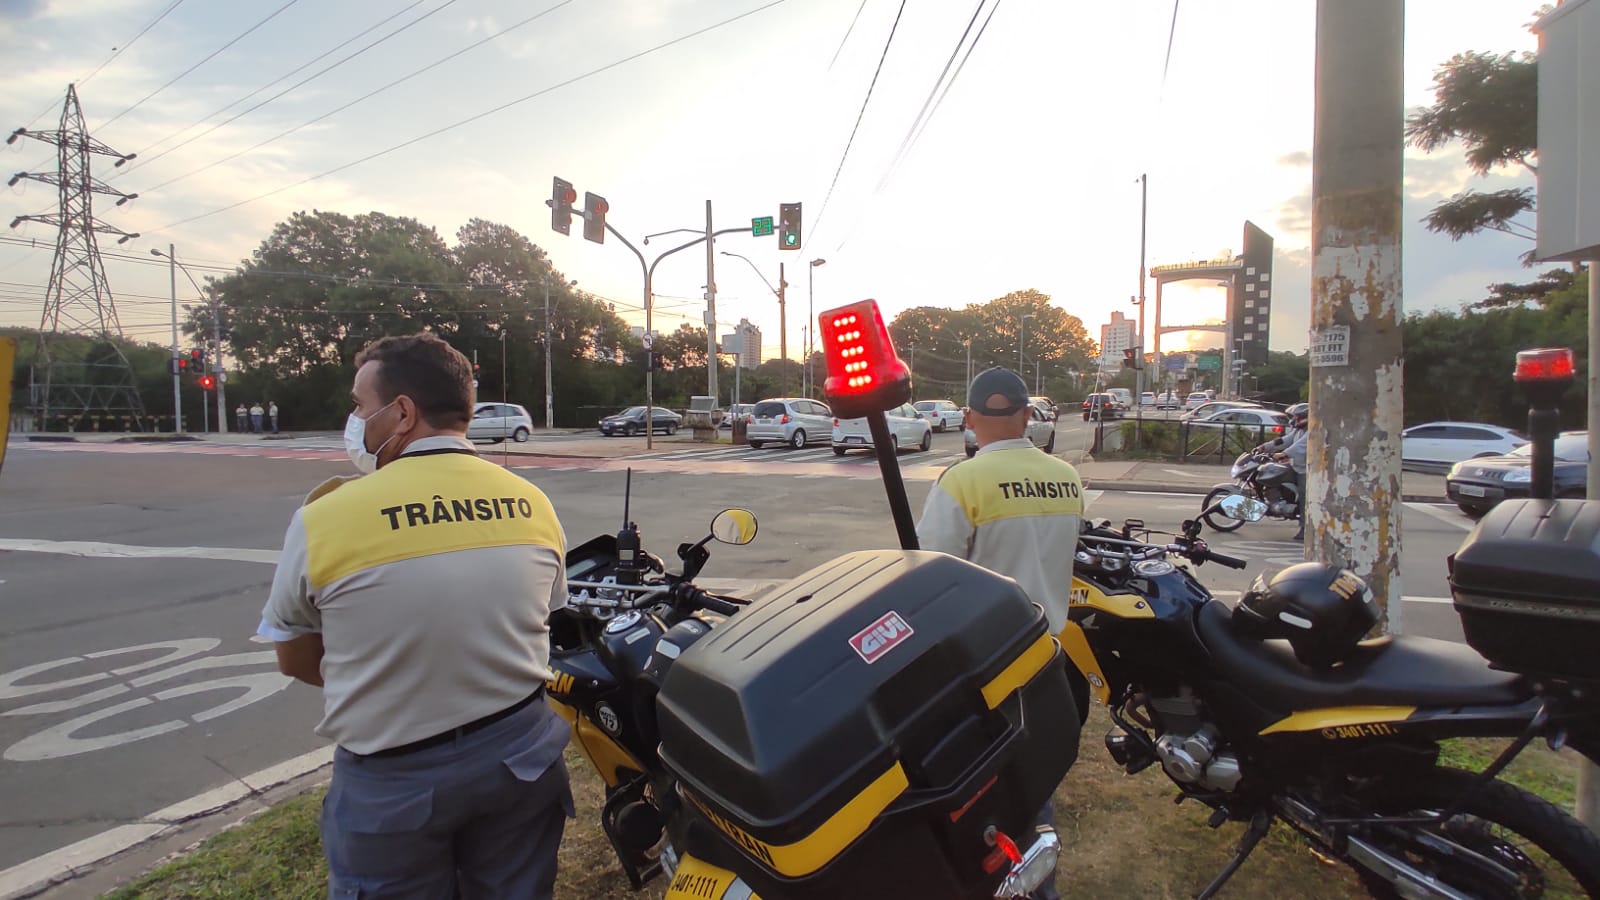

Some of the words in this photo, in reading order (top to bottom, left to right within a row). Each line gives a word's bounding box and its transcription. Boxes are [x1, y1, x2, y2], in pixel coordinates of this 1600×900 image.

[999, 478, 1079, 499] TRÂNSITO
[381, 495, 532, 530] TRÂNSITO
[861, 616, 906, 655] GIVI
